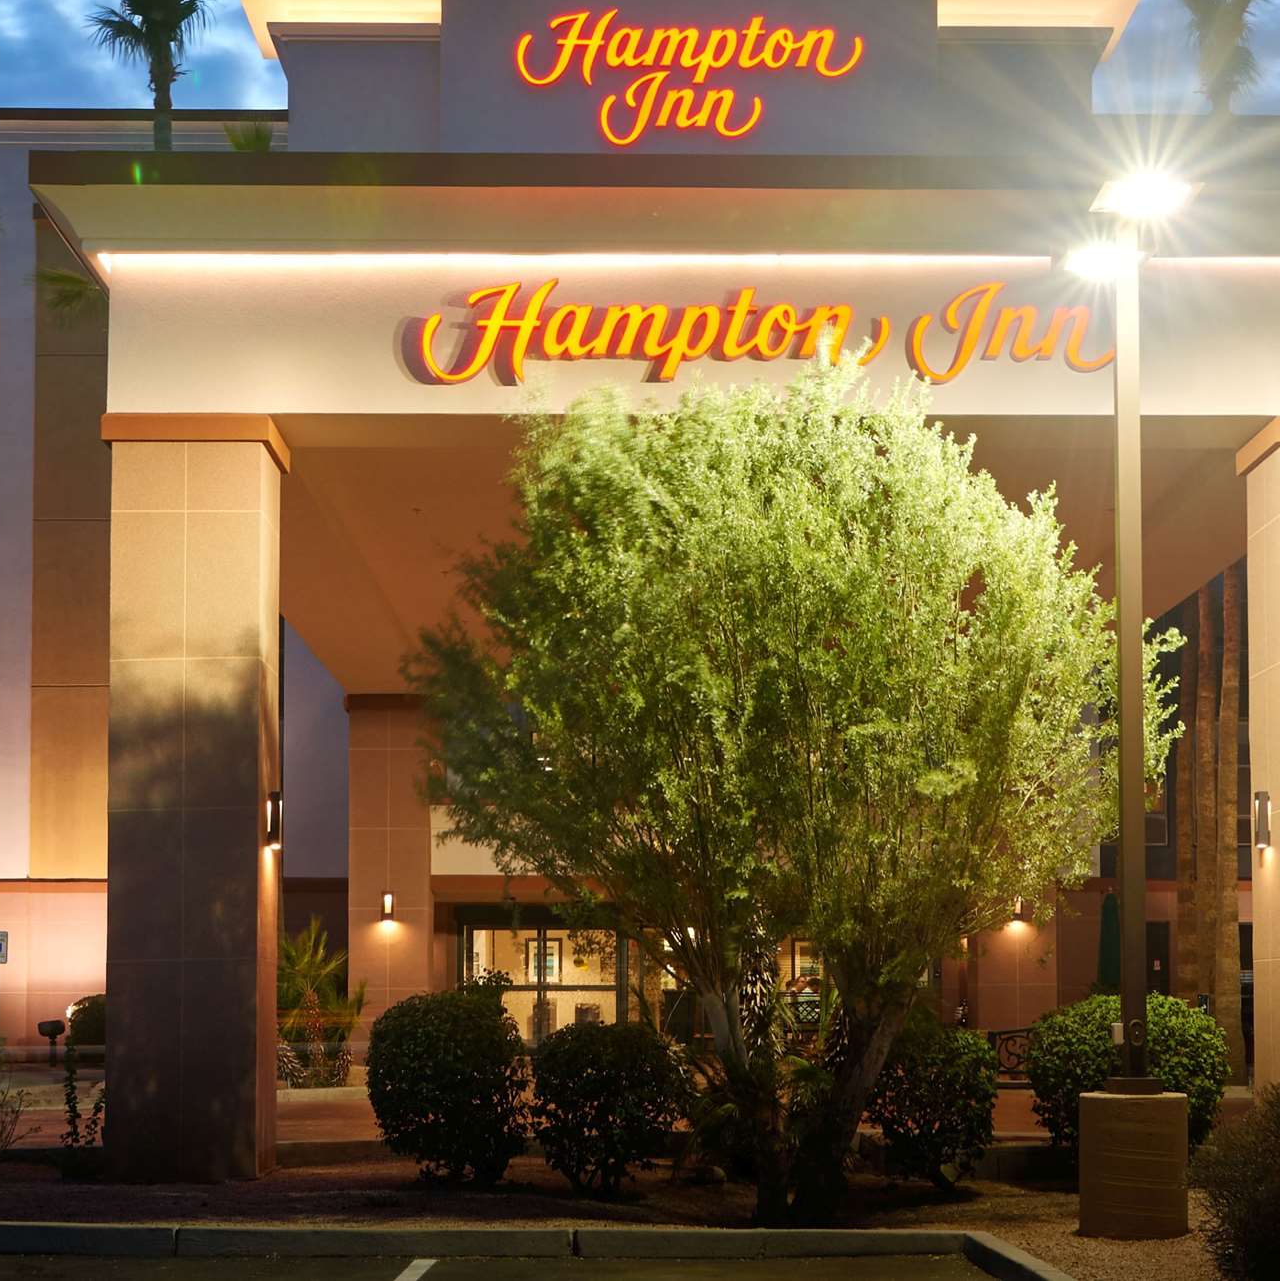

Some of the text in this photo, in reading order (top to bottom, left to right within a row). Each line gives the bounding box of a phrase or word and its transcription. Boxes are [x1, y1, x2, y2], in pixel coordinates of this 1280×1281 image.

[517, 9, 863, 85] Hampton
[600, 71, 761, 145] Inn
[421, 278, 1116, 384] Hampton Inn
